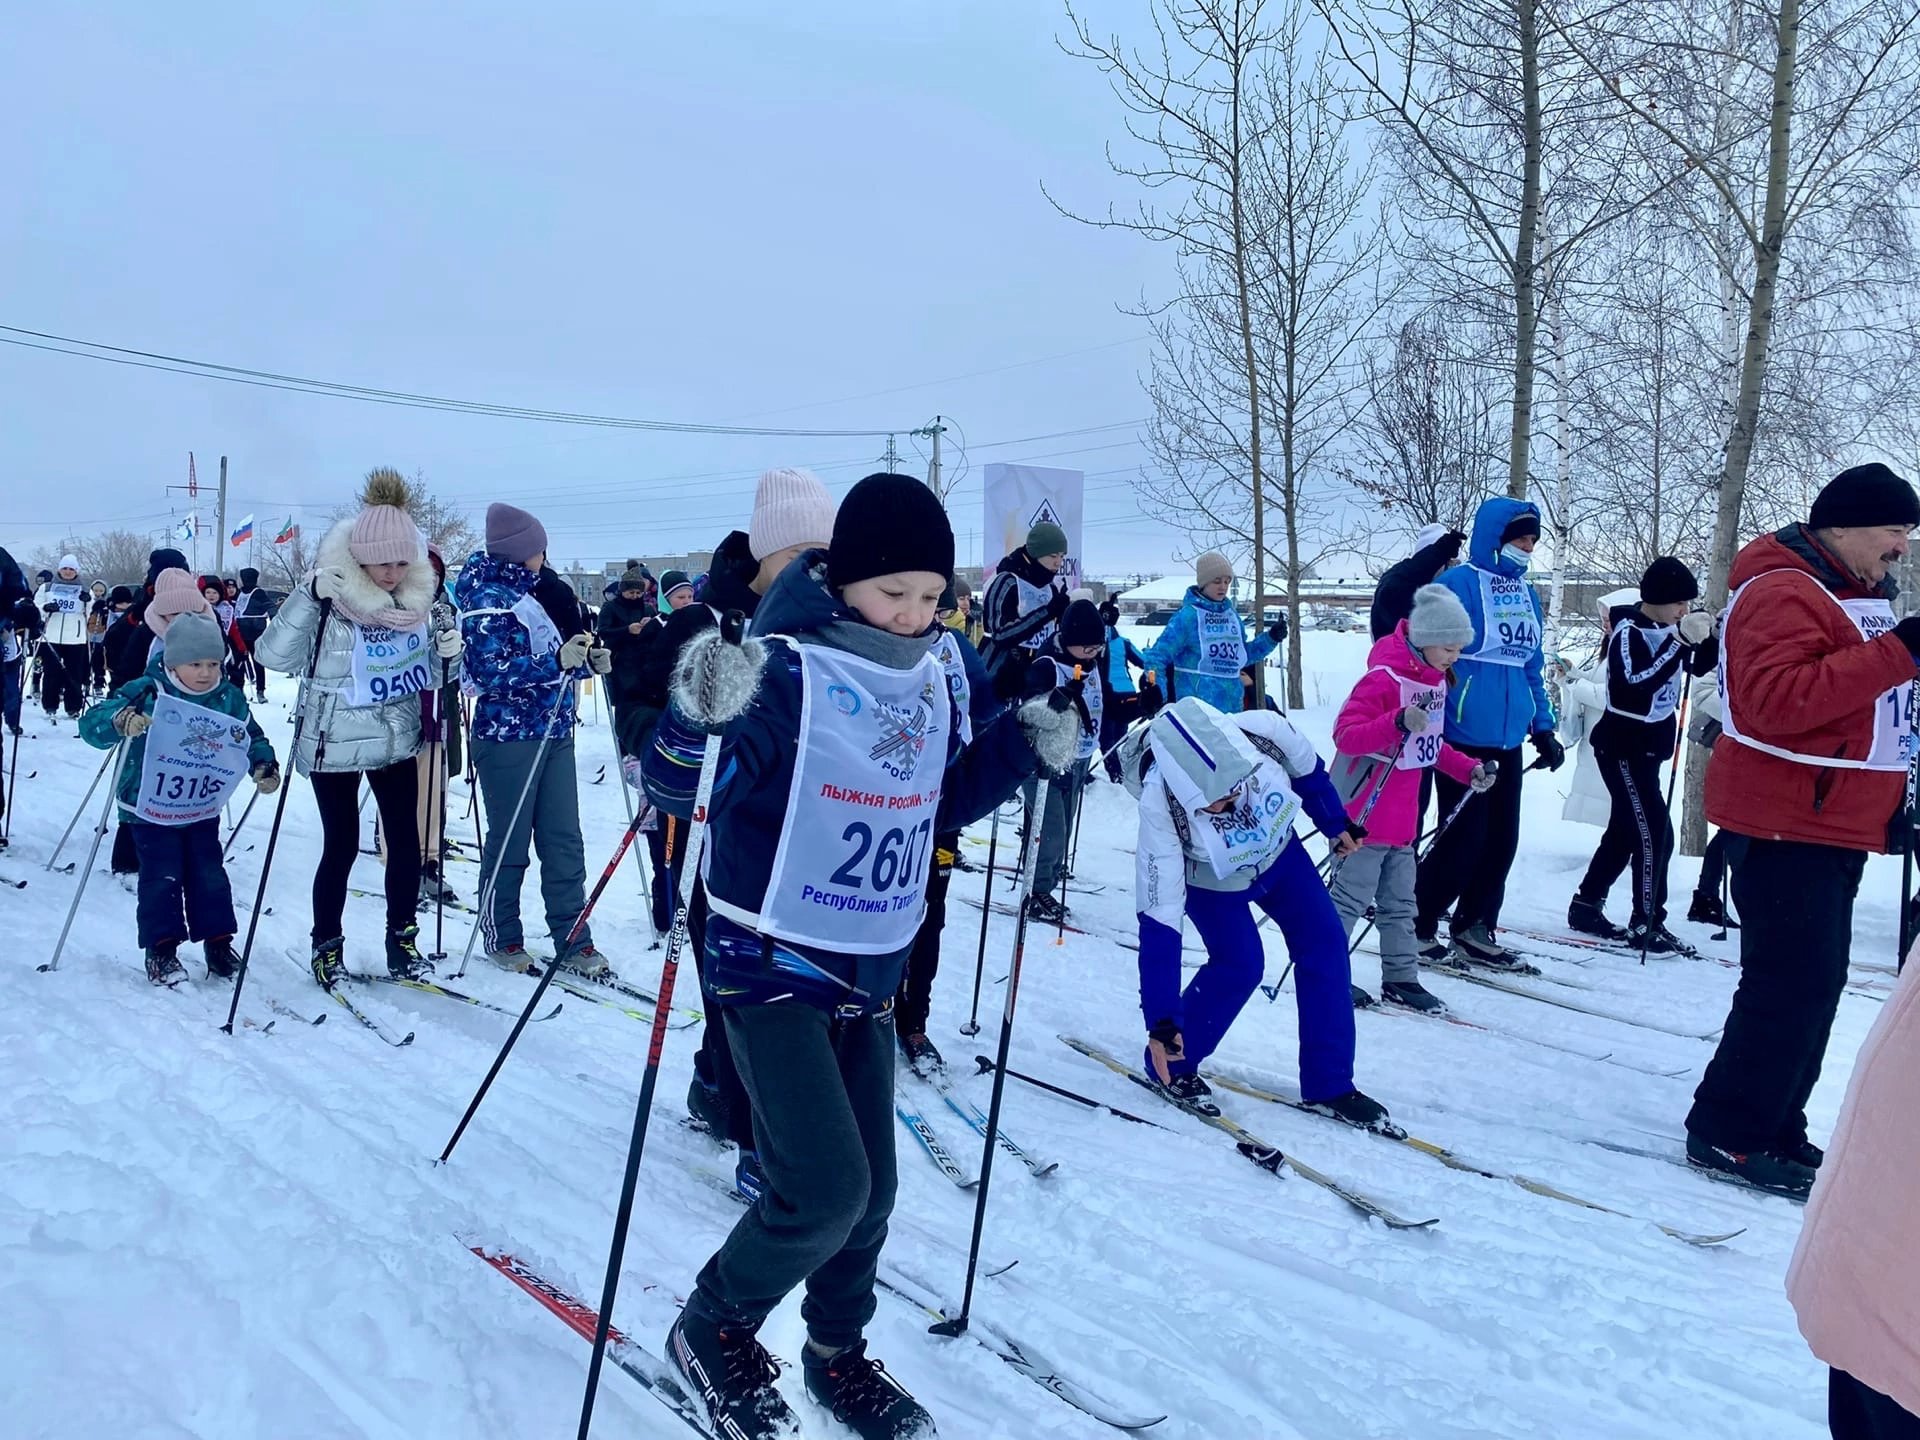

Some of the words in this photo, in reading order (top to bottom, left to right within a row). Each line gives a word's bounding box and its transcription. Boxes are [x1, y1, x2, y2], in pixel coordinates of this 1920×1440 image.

[1493, 594, 1522, 606] 202
[370, 664, 427, 703] 9500
[821, 784, 885, 809] ЛЫЖНЯ
[888, 793, 922, 811] РОССИИ
[829, 818, 931, 893] 2607
[677, 908, 687, 923] 30
[801, 885, 888, 913] Республика
[671, 923, 684, 963] CLASSIC
[914, 1123, 962, 1179] SABLE
[678, 1329, 752, 1440] SPINE
